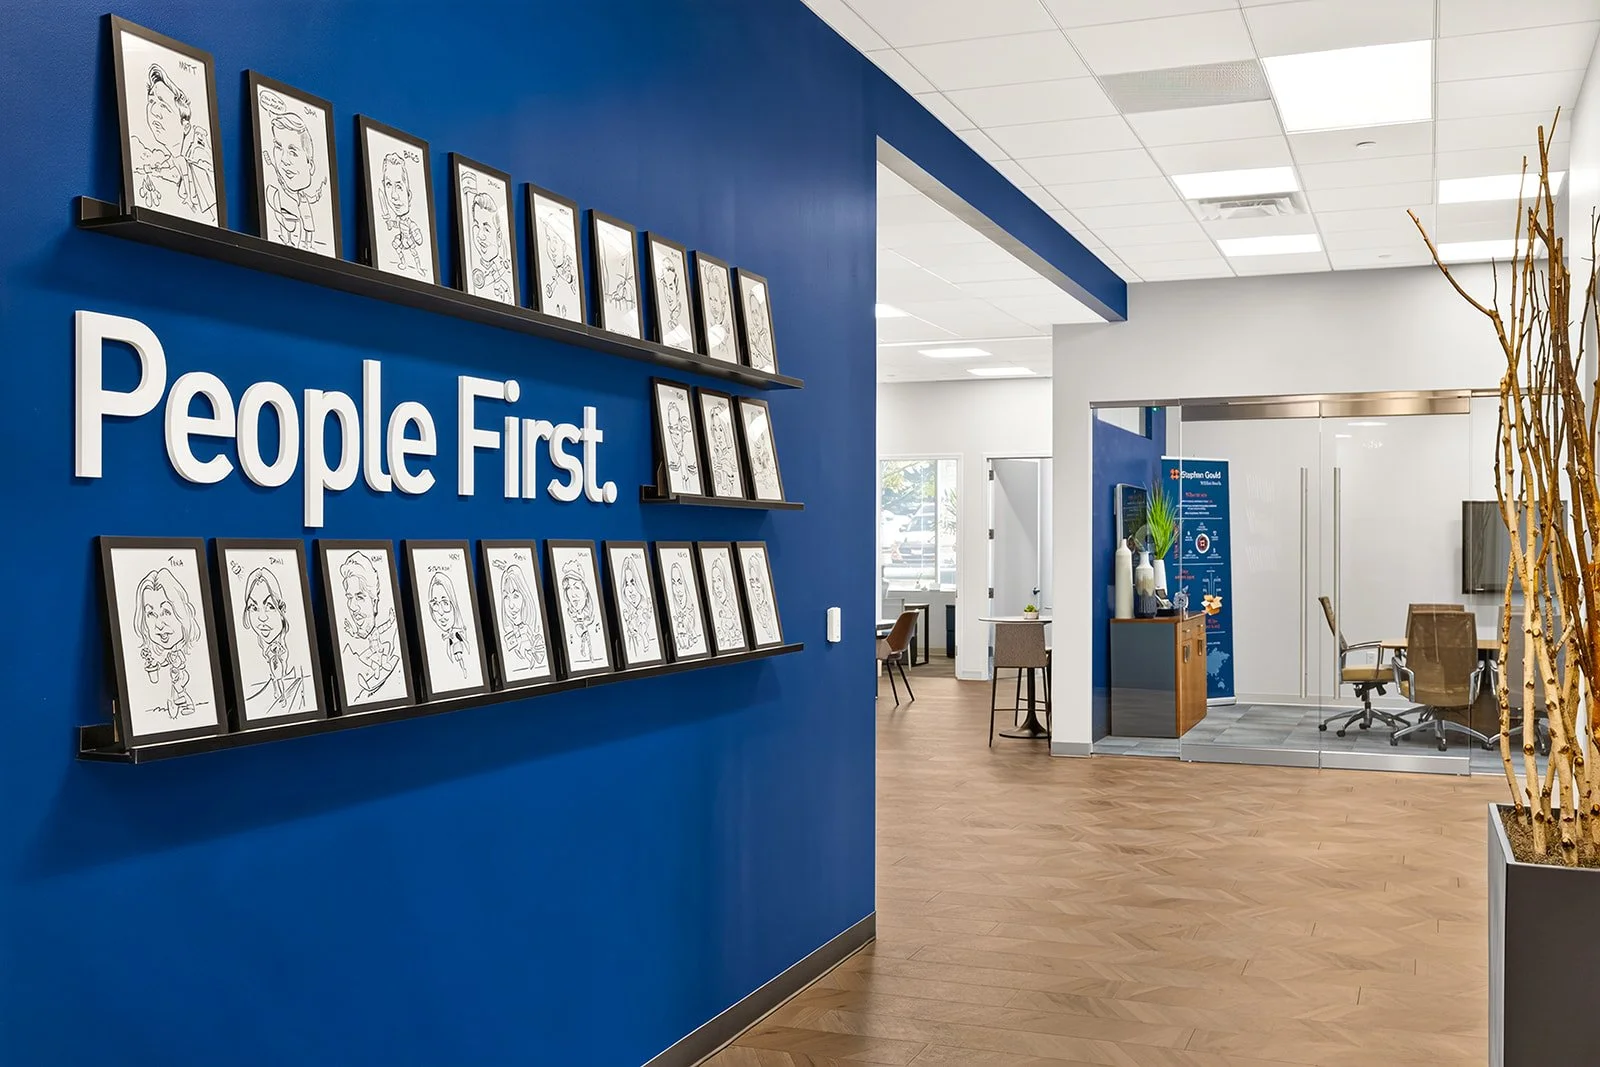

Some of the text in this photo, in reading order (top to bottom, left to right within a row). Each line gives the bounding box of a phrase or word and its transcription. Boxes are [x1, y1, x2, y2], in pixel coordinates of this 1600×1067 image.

[179, 61, 197, 75] MATT
[75, 310, 618, 528] People First.
[1205, 471, 1221, 479] Gould
